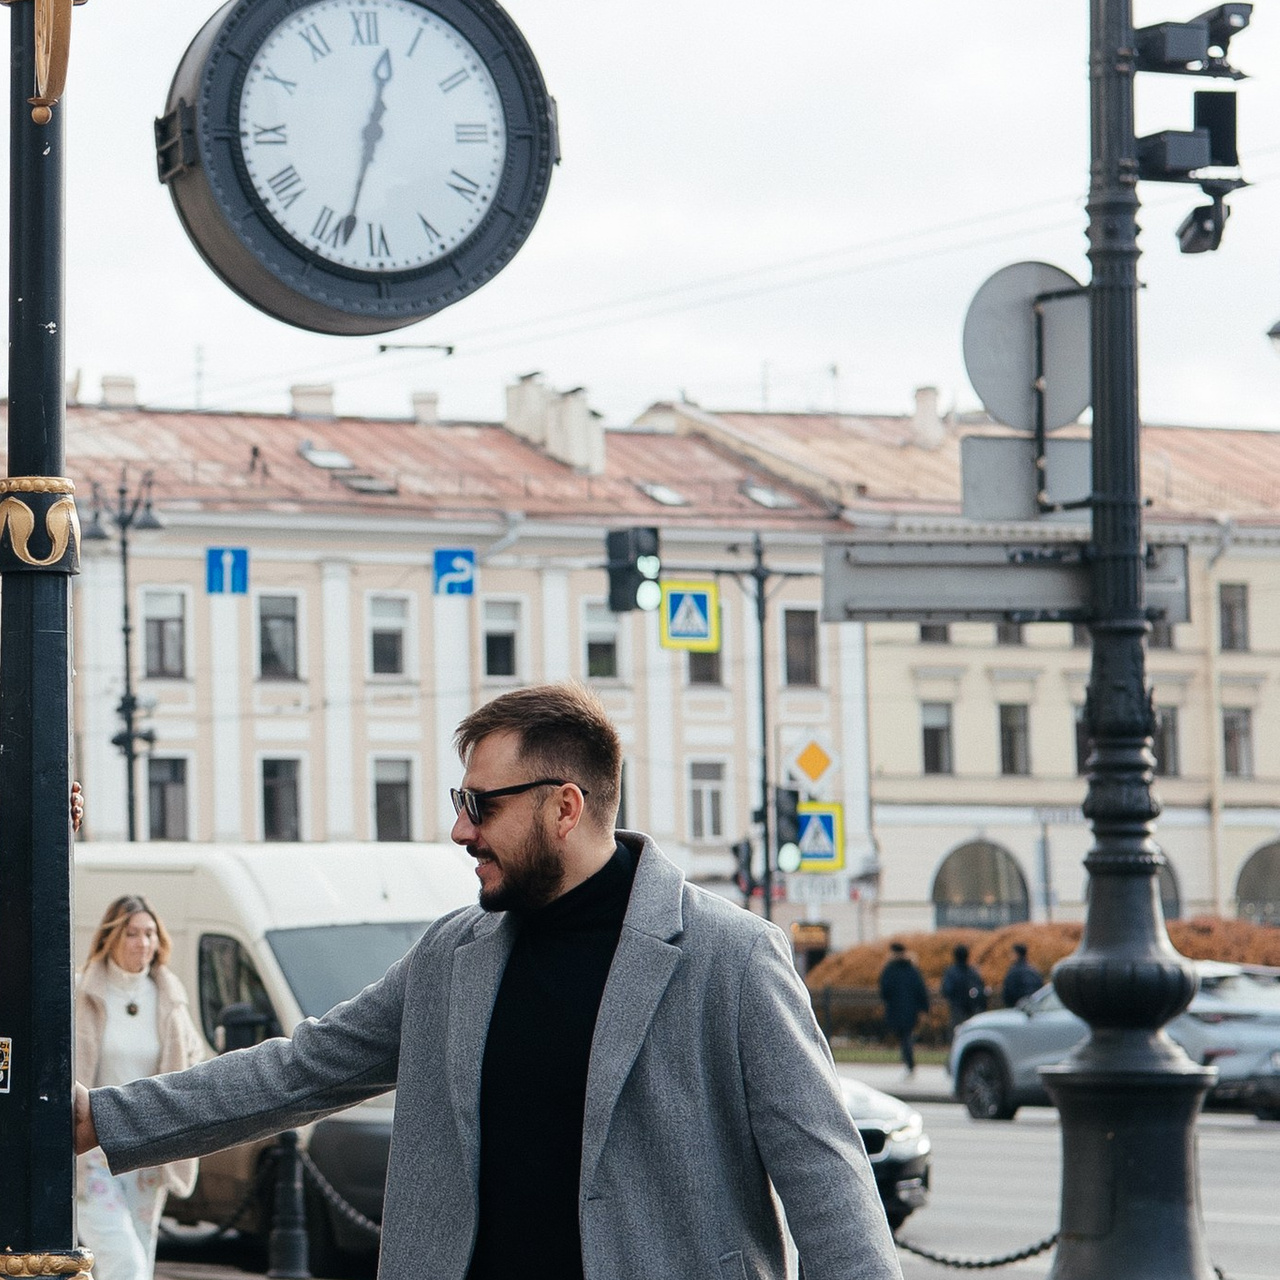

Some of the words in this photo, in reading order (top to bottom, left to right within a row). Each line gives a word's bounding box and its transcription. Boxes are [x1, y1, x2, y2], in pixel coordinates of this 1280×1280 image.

[299, 23, 331, 63] XI
[349, 11, 379, 47] XII
[406, 28, 425, 58] I
[263, 67, 296, 95] X
[439, 68, 470, 93] II
[254, 124, 287, 146] IX
[455, 123, 488, 144] III
[268, 165, 306, 209] VIII
[447, 170, 480, 204] IV
[368, 223, 390, 258] VI
[417, 213, 441, 244] V
